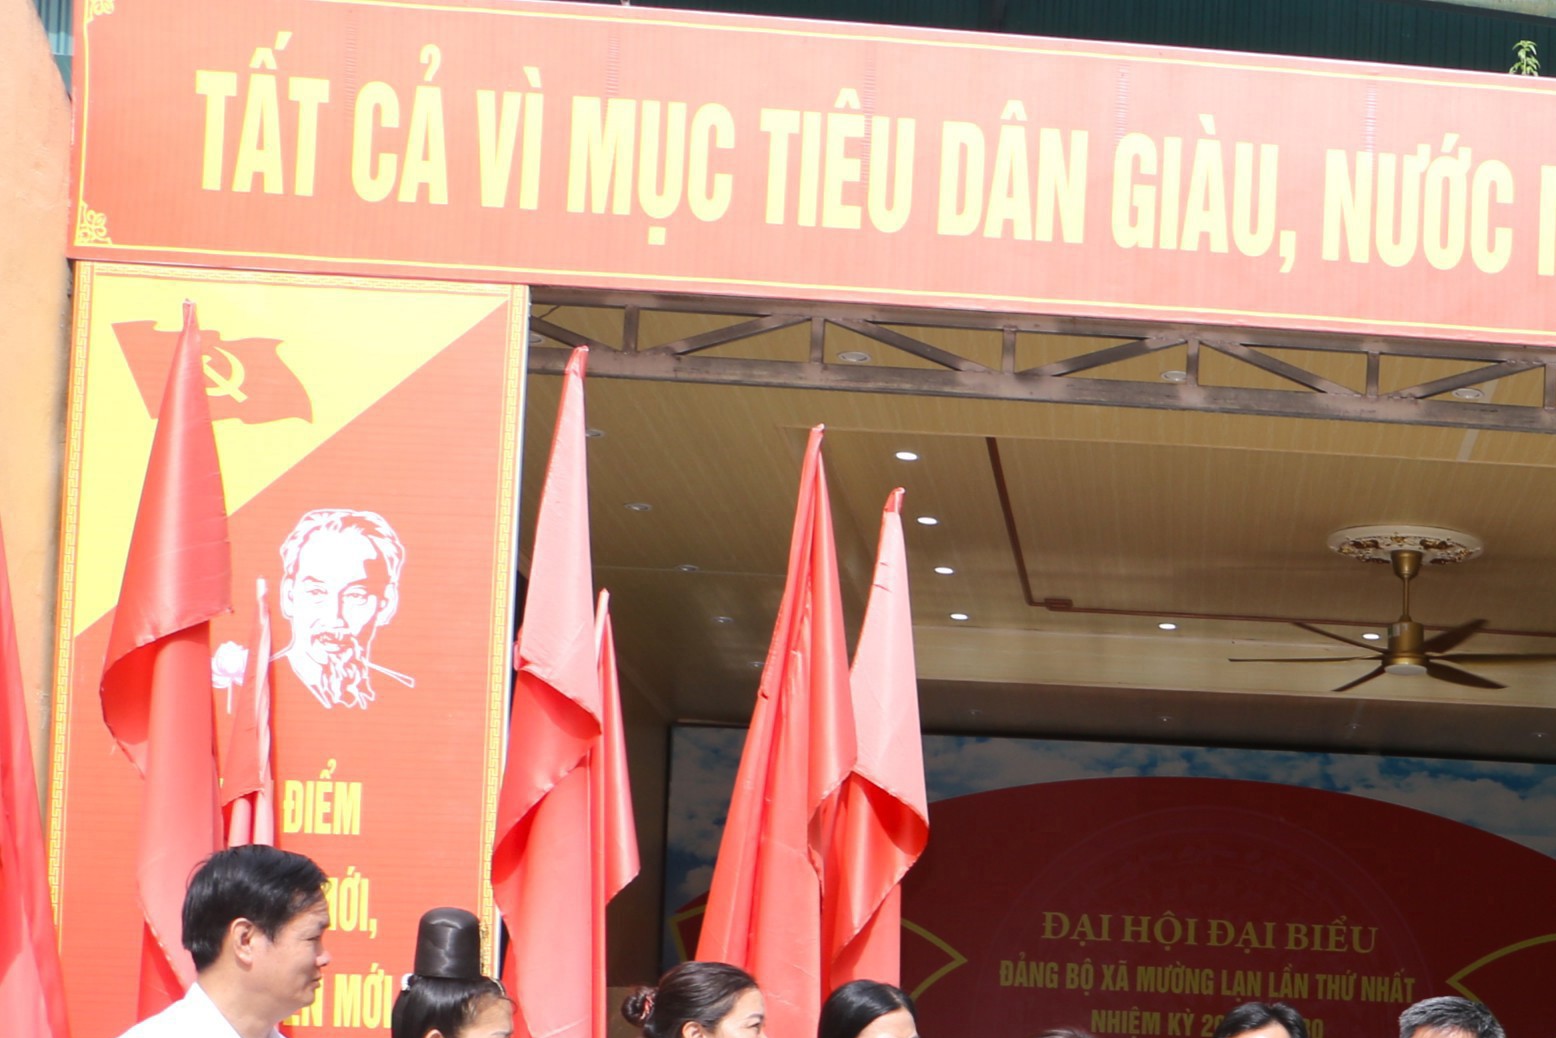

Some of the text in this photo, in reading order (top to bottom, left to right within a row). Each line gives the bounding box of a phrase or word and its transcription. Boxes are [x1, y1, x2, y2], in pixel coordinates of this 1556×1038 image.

[196, 31, 330, 197] TẤT
[351, 43, 449, 206] CẢ
[475, 67, 544, 211] VÌ
[567, 95, 736, 246] MỤC
[760, 88, 916, 234] TIÊU
[937, 100, 1090, 244] DÂN
[1111, 114, 1297, 274] GIÀU,
[1322, 134, 1515, 275] NƯỚC
[283, 758, 362, 835] ĐIỂM
[1041, 910, 1378, 954] ĐẠI HỘI ĐẠI BIỂU
[333, 962, 393, 1029] MỚI
[1000, 952, 1415, 1003] ĐẢNG BỘ XÃ MƯỜNG LẠN LẦN THỨ NHẤT
[1168, 1008, 1194, 1036] KỲ
